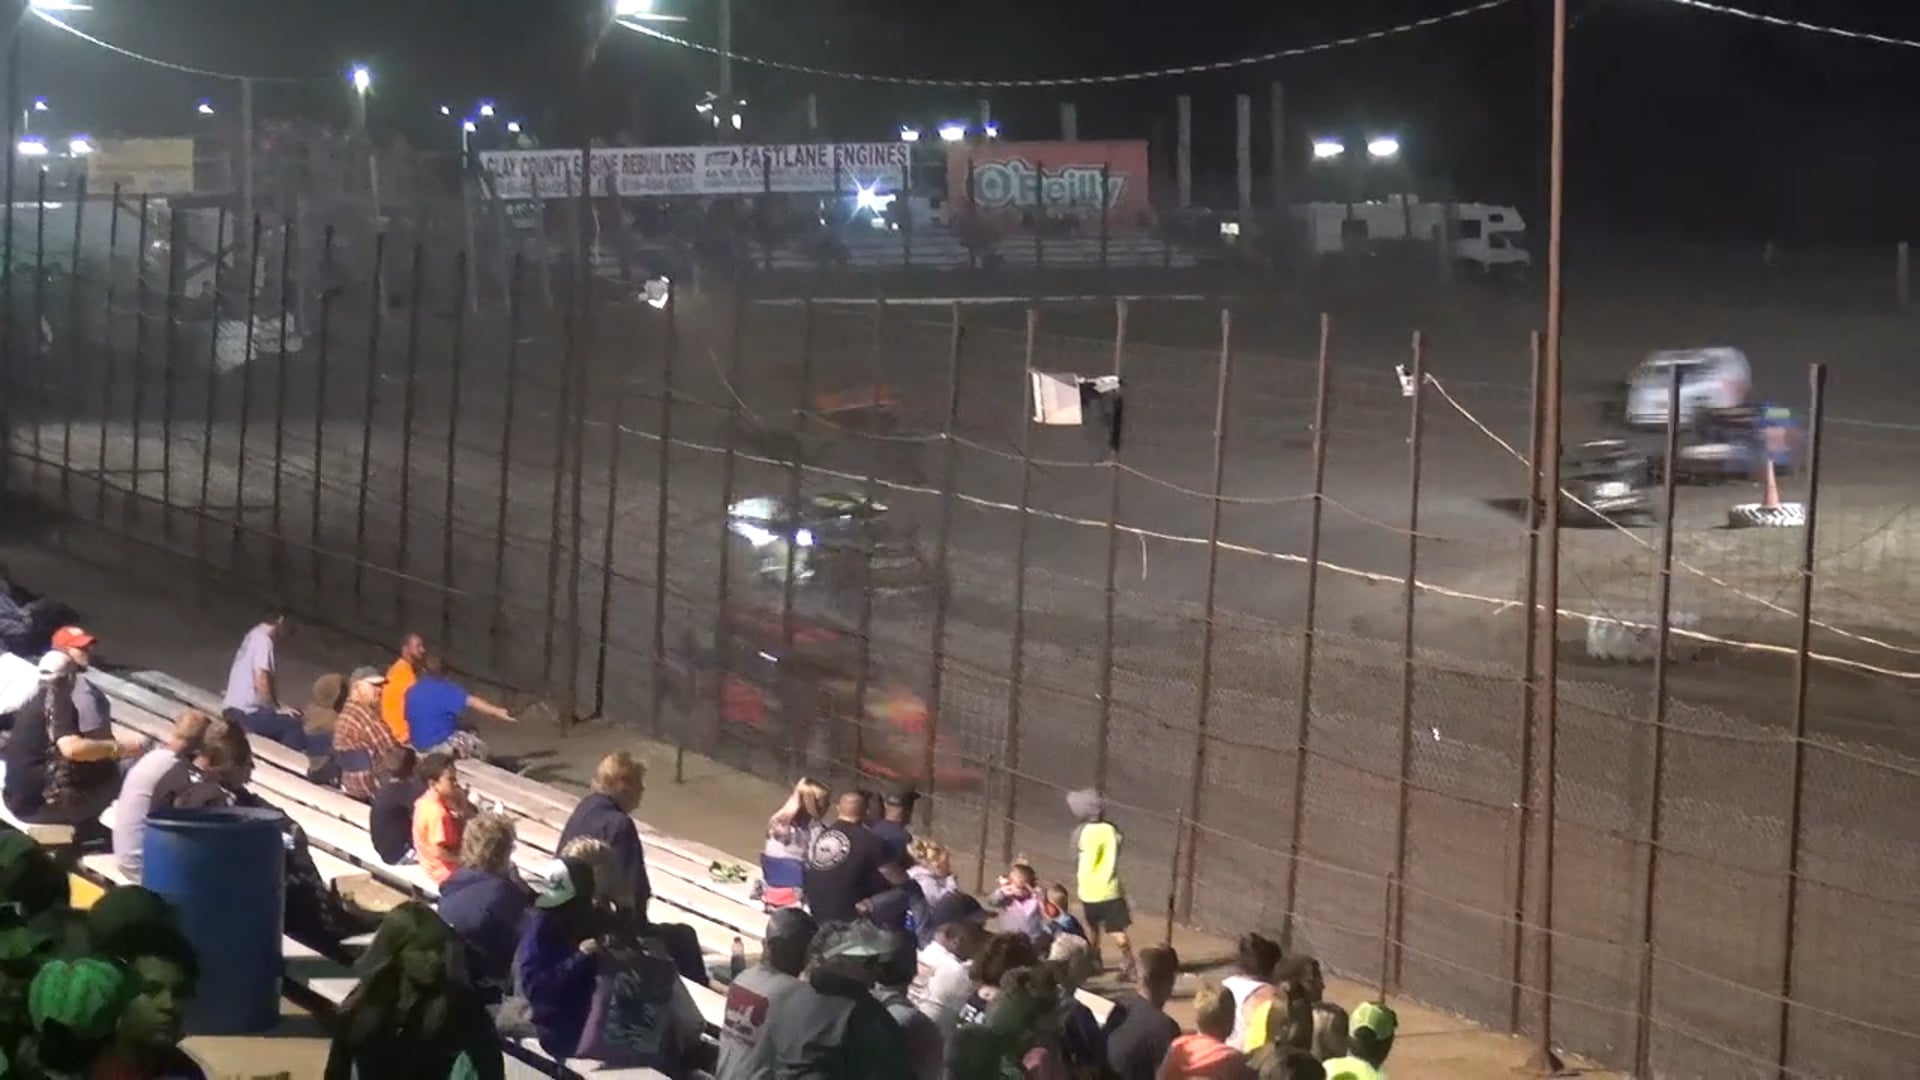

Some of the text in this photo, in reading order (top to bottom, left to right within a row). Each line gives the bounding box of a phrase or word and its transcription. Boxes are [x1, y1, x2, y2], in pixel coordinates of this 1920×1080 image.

[487, 152, 696, 178] CLAY COUNTY EGINE REBUILDERS
[742, 143, 908, 169] FASTLANE ENGINES
